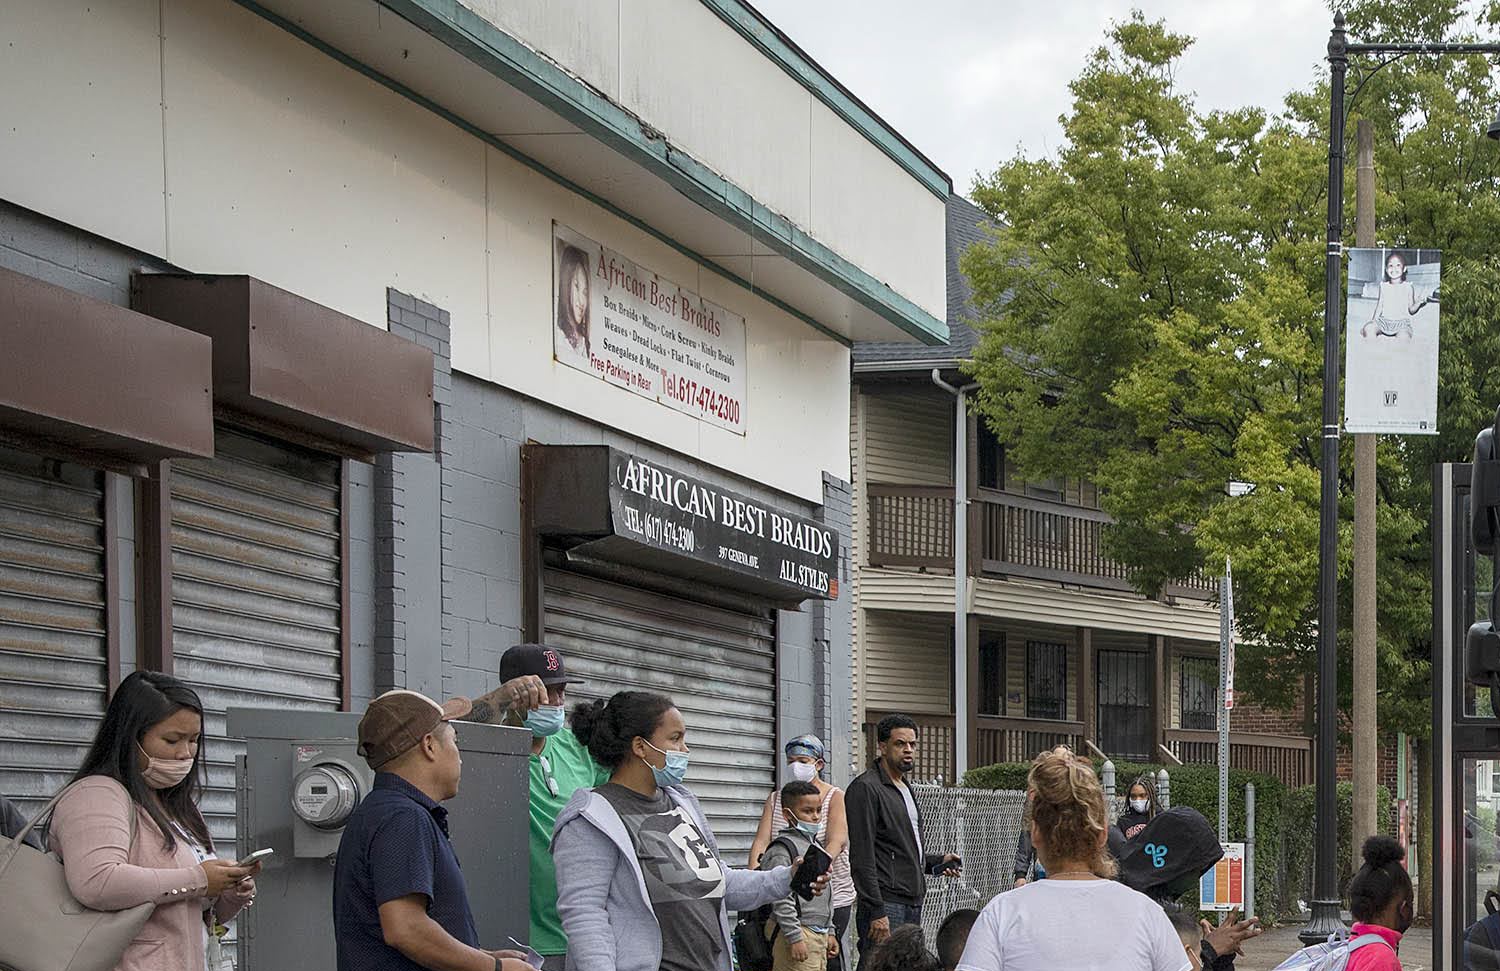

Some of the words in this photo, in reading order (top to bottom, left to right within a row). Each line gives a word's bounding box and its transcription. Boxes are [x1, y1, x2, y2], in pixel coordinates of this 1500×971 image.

[596, 252, 646, 300] African
[650, 280, 677, 317] Best
[681, 295, 721, 337] Braids
[604, 296, 617, 312] Box
[618, 301, 638, 321] Braids
[642, 314, 657, 332] Micro
[661, 325, 679, 341] Cork
[677, 332, 697, 349] Screw
[701, 341, 717, 361] Kinky
[717, 349, 735, 367] Braids
[604, 317, 628, 338] Weaves
[632, 330, 649, 347] Dread
[650, 338, 666, 356] Locks
[671, 349, 685, 363] Flat
[685, 354, 702, 371] Twist
[705, 362, 731, 383] Cornrows
[590, 353, 605, 372] Free
[606, 359, 631, 386] Parking
[631, 370, 636, 384] in
[637, 372, 651, 392] Rear
[603, 337, 638, 363] Senegalese
[639, 354, 645, 366] &
[645, 358, 660, 374] More
[621, 459, 717, 522] AFRICAN
[721, 495, 767, 538] BEST
[770, 513, 832, 559] BRAIDS
[644, 511, 662, 546] (617)
[664, 519, 695, 553] 474-2300
[718, 545, 728, 560] 397
[728, 548, 748, 566] GENEVA
[779, 559, 797, 583] ALL
[798, 564, 829, 593] STYLES
